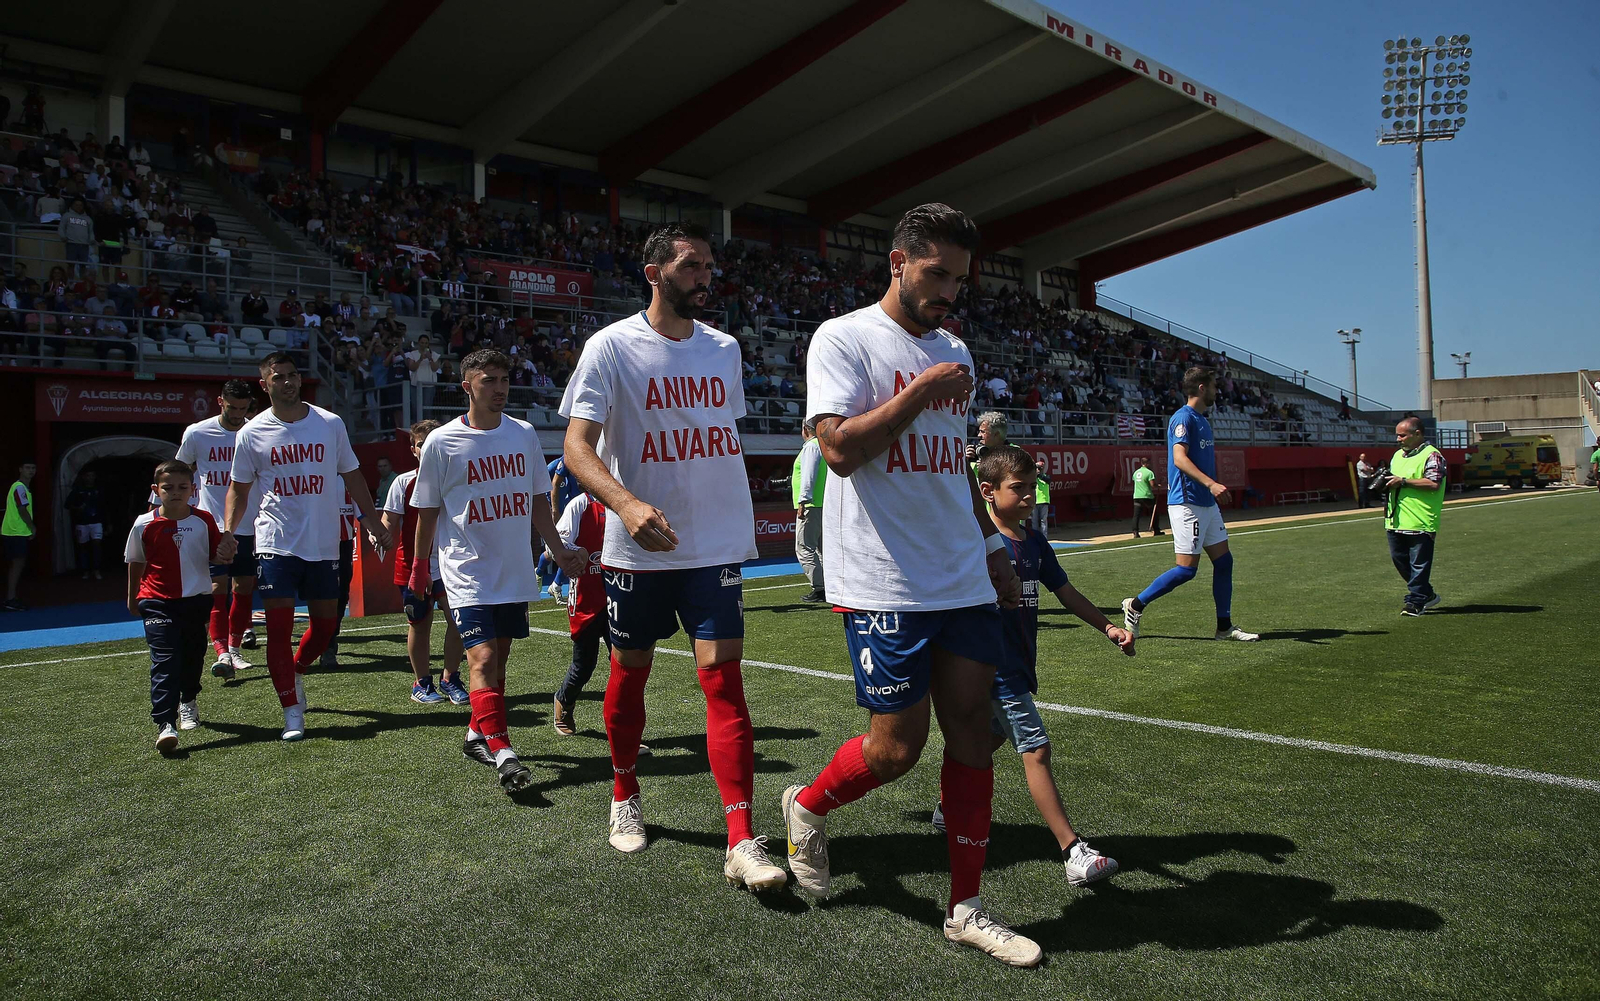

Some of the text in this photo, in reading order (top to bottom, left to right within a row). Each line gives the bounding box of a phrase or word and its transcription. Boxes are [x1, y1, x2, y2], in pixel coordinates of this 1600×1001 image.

[1046, 14, 1217, 107] MIRADOR
[508, 270, 556, 285] APOLO
[78, 390, 184, 401] ALGECIRAS CF
[645, 376, 726, 411] ANIMO
[82, 404, 131, 413] Ayuntamiento
[143, 405, 181, 414] Algeciras
[270, 443, 325, 466] ANIMO
[467, 453, 526, 485] ANIMO
[1192, 521, 1200, 537] 6
[453, 608, 462, 626] 2
[606, 595, 618, 622] 21
[859, 647, 874, 676] 4
[865, 681, 911, 695] GIVOVA
